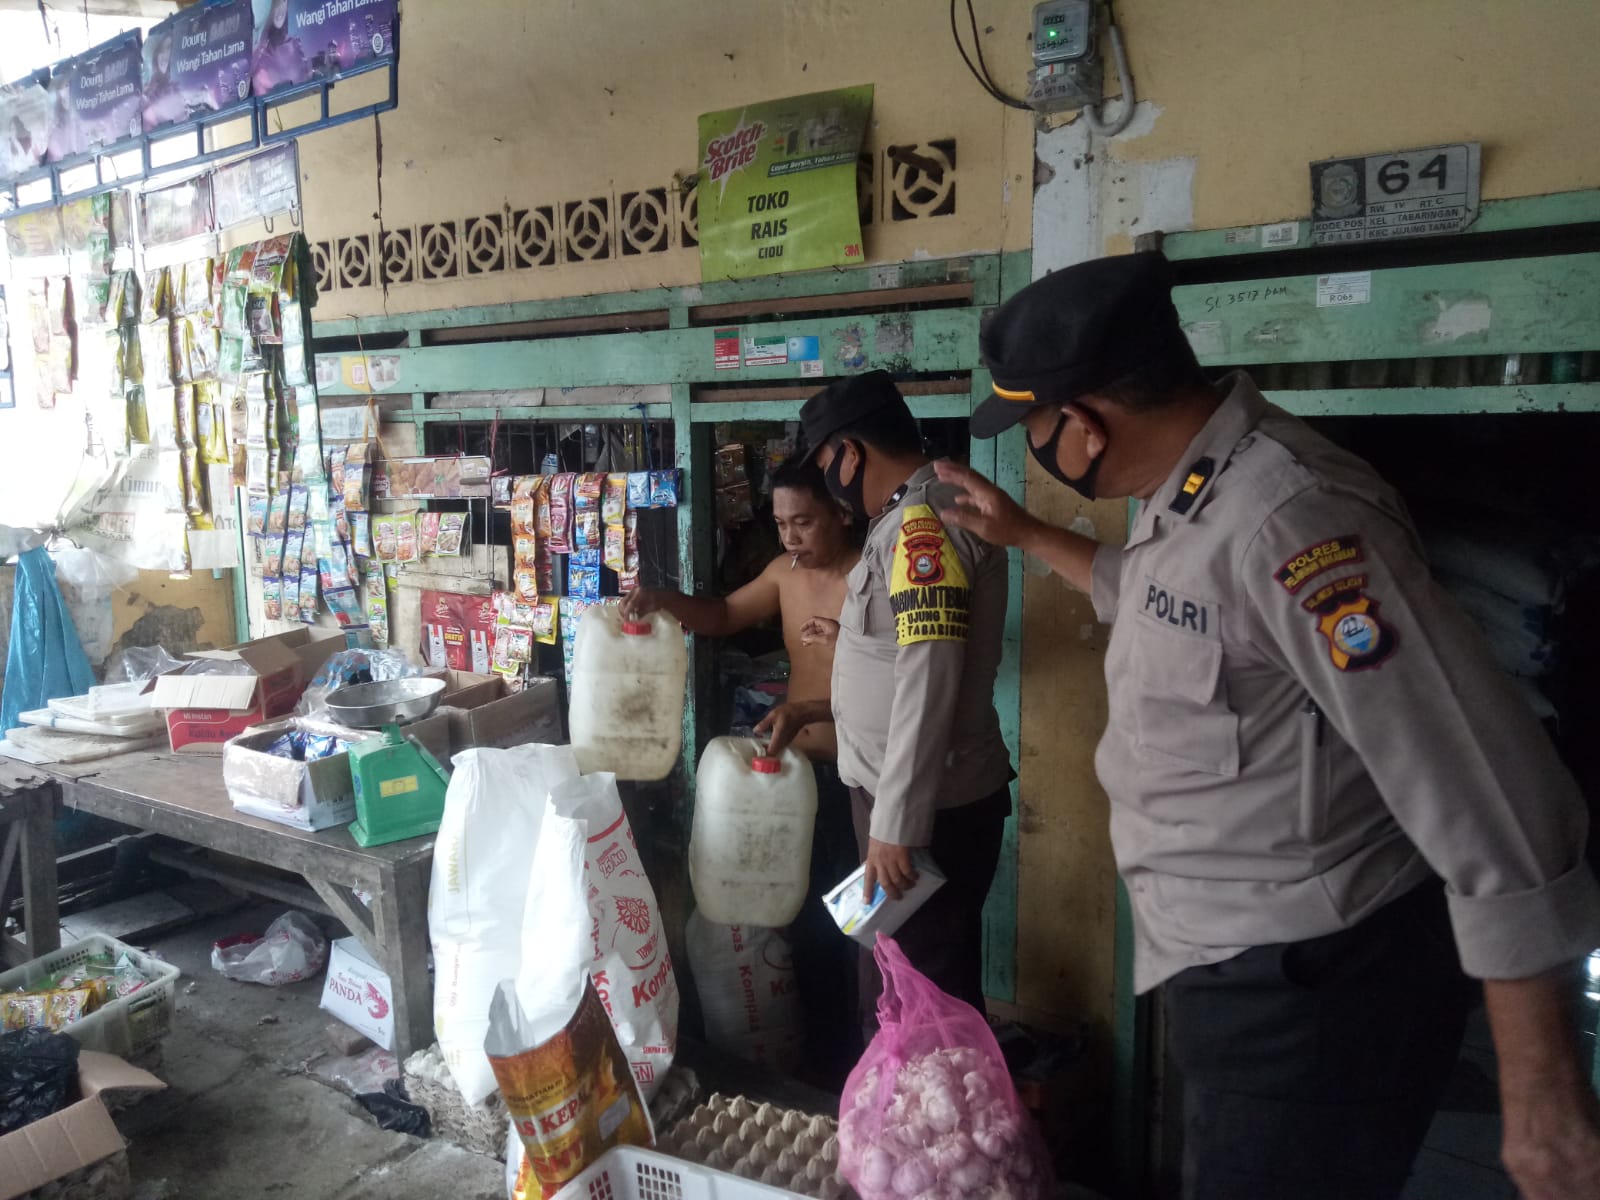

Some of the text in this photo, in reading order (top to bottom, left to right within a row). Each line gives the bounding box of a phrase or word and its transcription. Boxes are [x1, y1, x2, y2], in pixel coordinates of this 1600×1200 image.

[296, 5, 326, 28] Wangi
[182, 31, 207, 48] Downy
[177, 40, 245, 73] Wangi Tahan Lama
[1378, 154, 1448, 195] 64
[747, 190, 789, 214] TOKO
[1370, 205, 1385, 213] RW
[751, 219, 788, 240] RAIS
[1315, 219, 1363, 231] KODE POS
[1370, 217, 1387, 225] KEL
[1368, 229, 1389, 238] KEC
[844, 244, 860, 257] 3M
[1287, 540, 1341, 573] POLRES
[907, 610, 940, 624] UJUNG
[1145, 584, 1207, 634] POLRI
[329, 977, 362, 1006] PANDA
